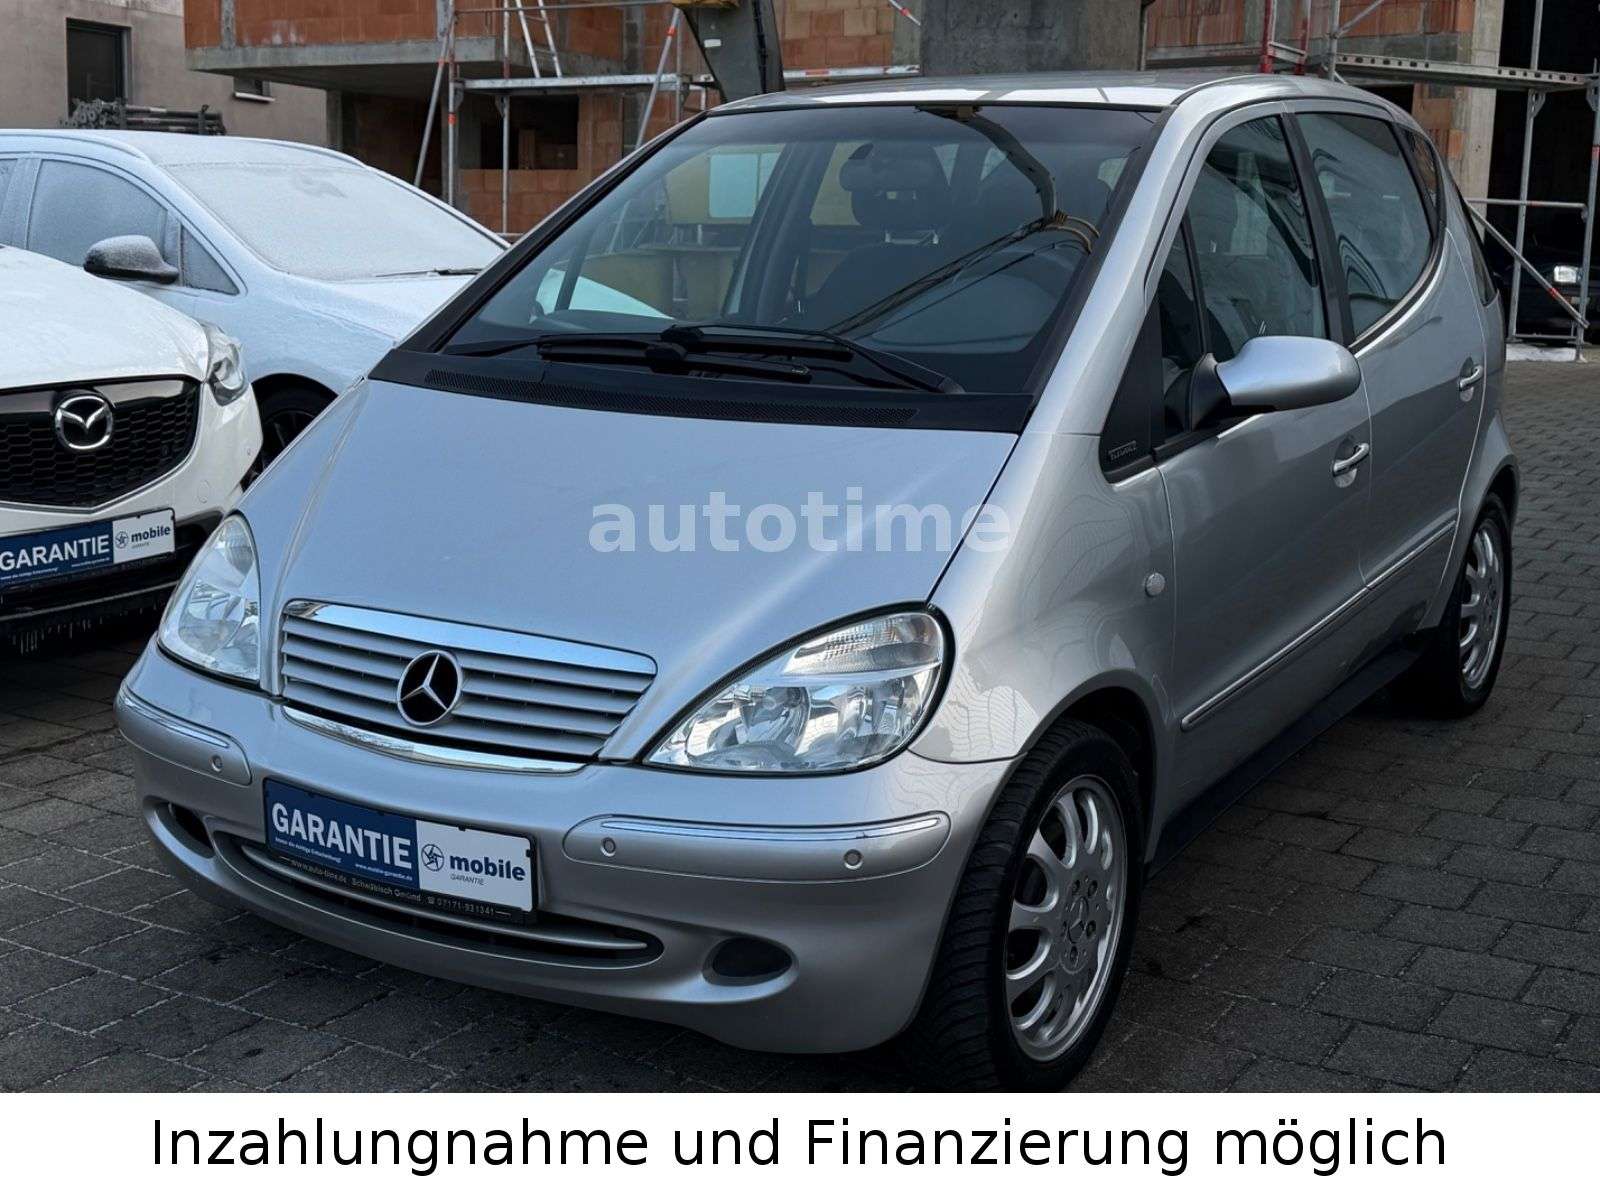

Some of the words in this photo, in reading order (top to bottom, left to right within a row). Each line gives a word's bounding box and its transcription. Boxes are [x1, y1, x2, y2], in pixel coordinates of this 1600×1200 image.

[131, 524, 171, 543] mobile
[0, 535, 111, 571] GARANTIE
[272, 802, 412, 869] GARANTIE
[449, 855, 526, 881] mobile
